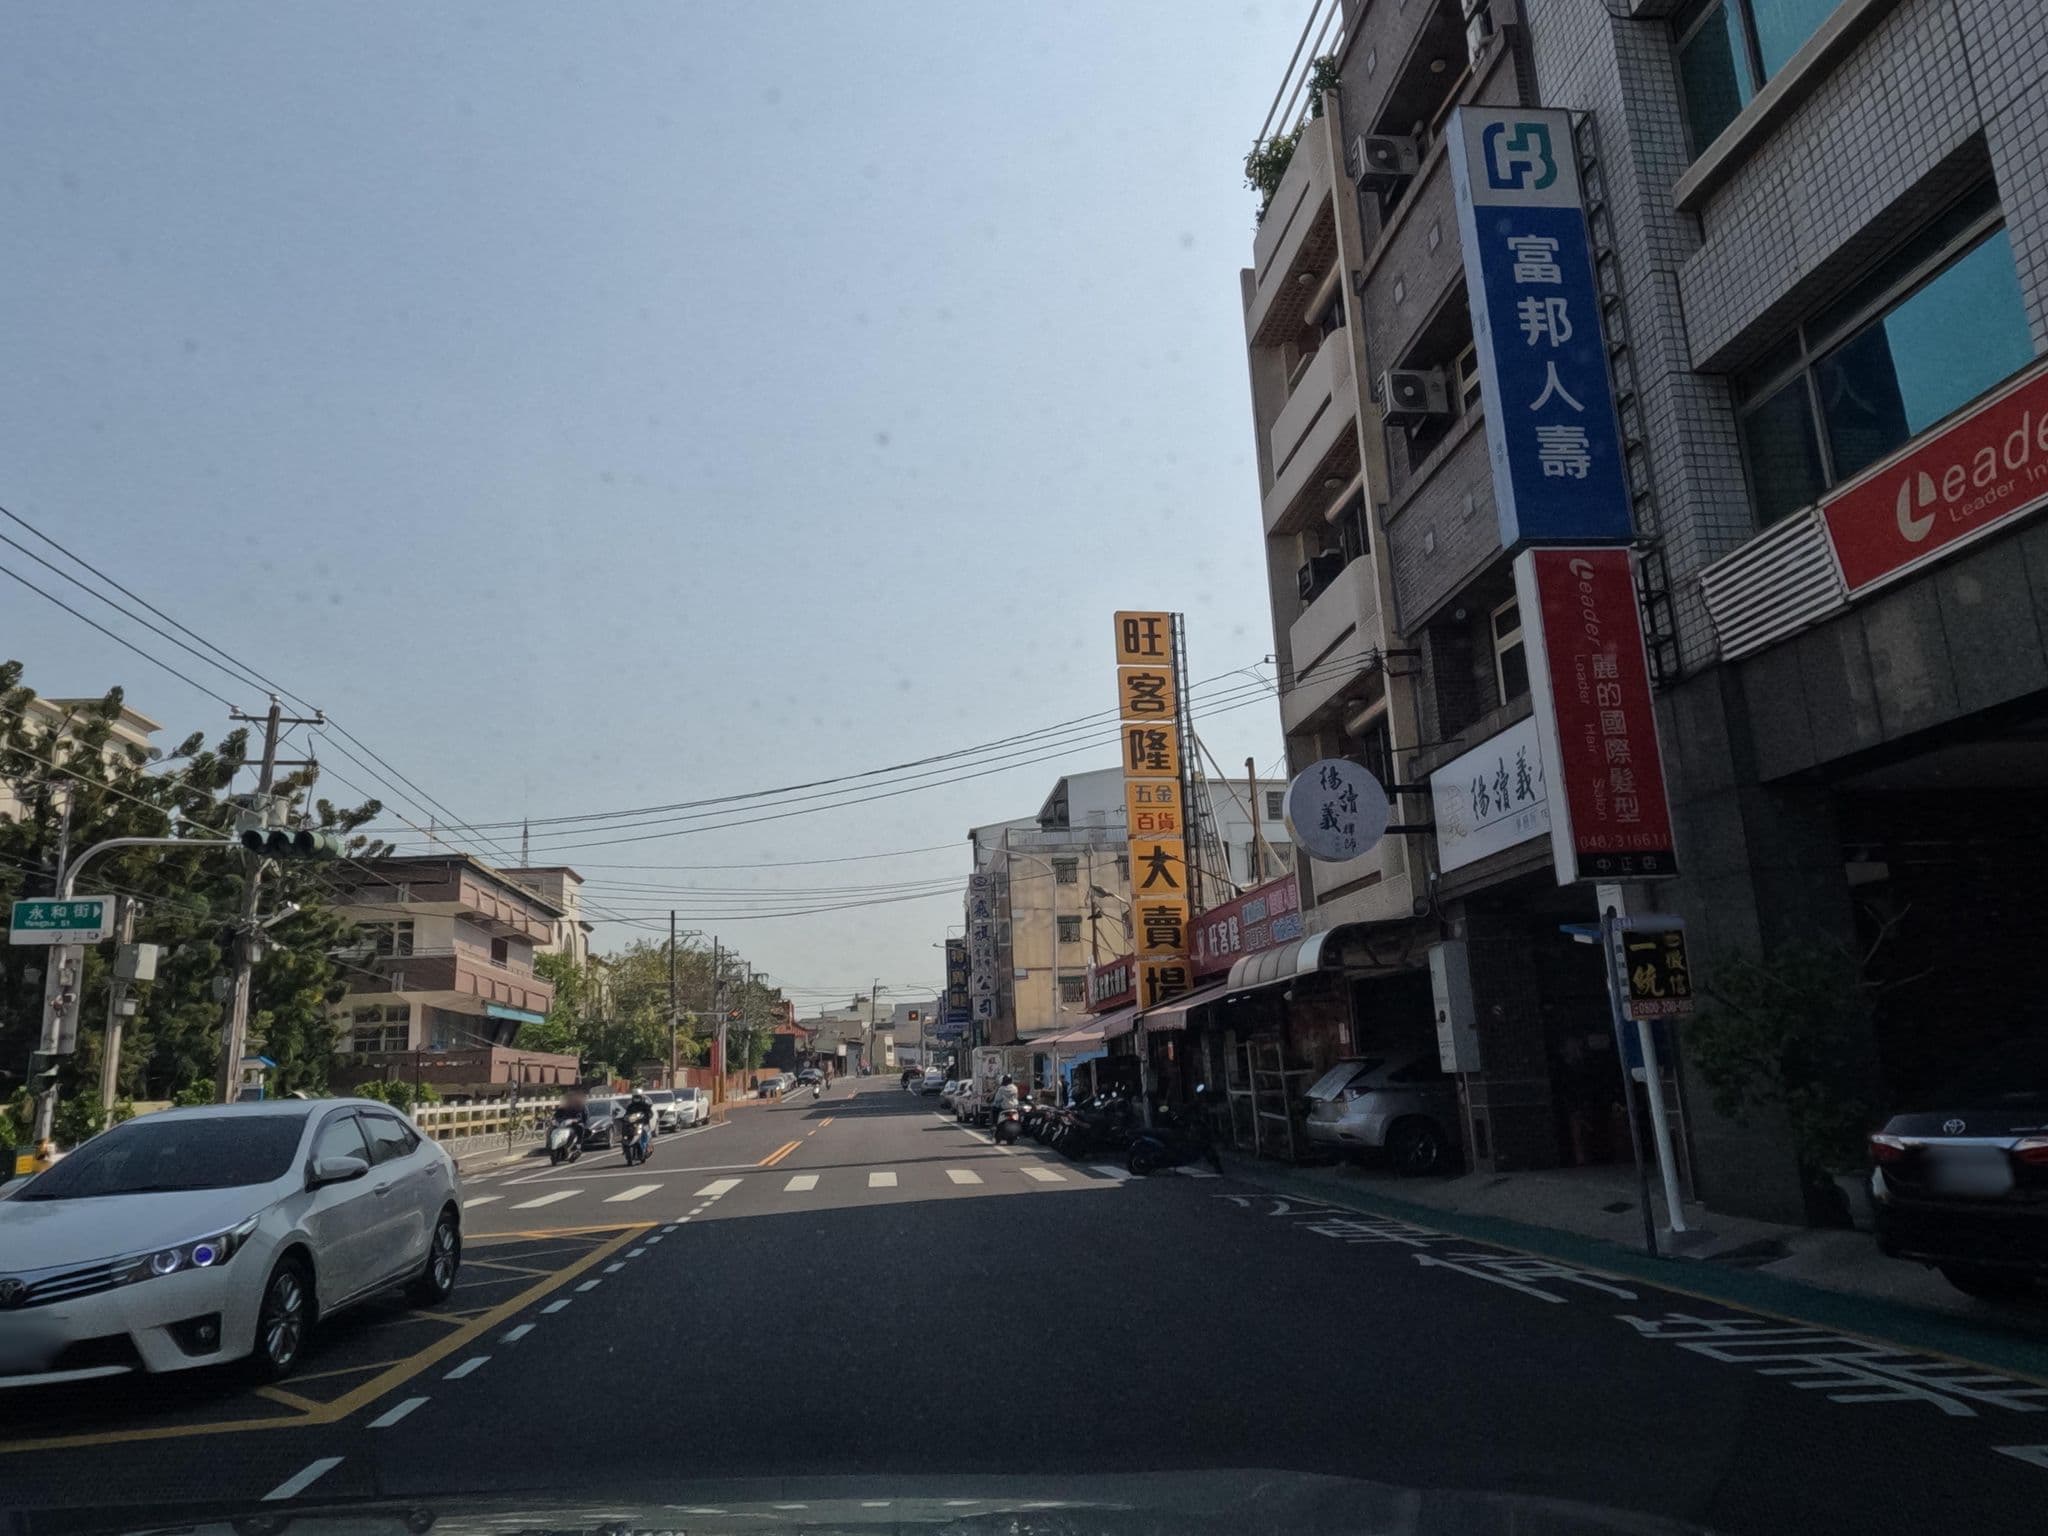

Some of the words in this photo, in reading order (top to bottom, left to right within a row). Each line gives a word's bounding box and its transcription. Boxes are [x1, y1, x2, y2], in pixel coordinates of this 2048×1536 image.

[1507, 234, 1592, 480] 富邦人壽
[1949, 480, 2018, 522] Leader
[2025, 462, 2048, 483] In
[1569, 557, 1602, 646] Leader
[1123, 617, 1172, 771] 旺客隆
[1585, 723, 1600, 753] Hair
[1592, 650, 1641, 824] 麗的國際髮型
[1135, 784, 1174, 803] 五金
[1136, 811, 1175, 831] 百貨
[28, 904, 90, 920] 永和街
[1138, 845, 1187, 1001] 大賣場
[1208, 914, 1241, 957] 旺客隆
